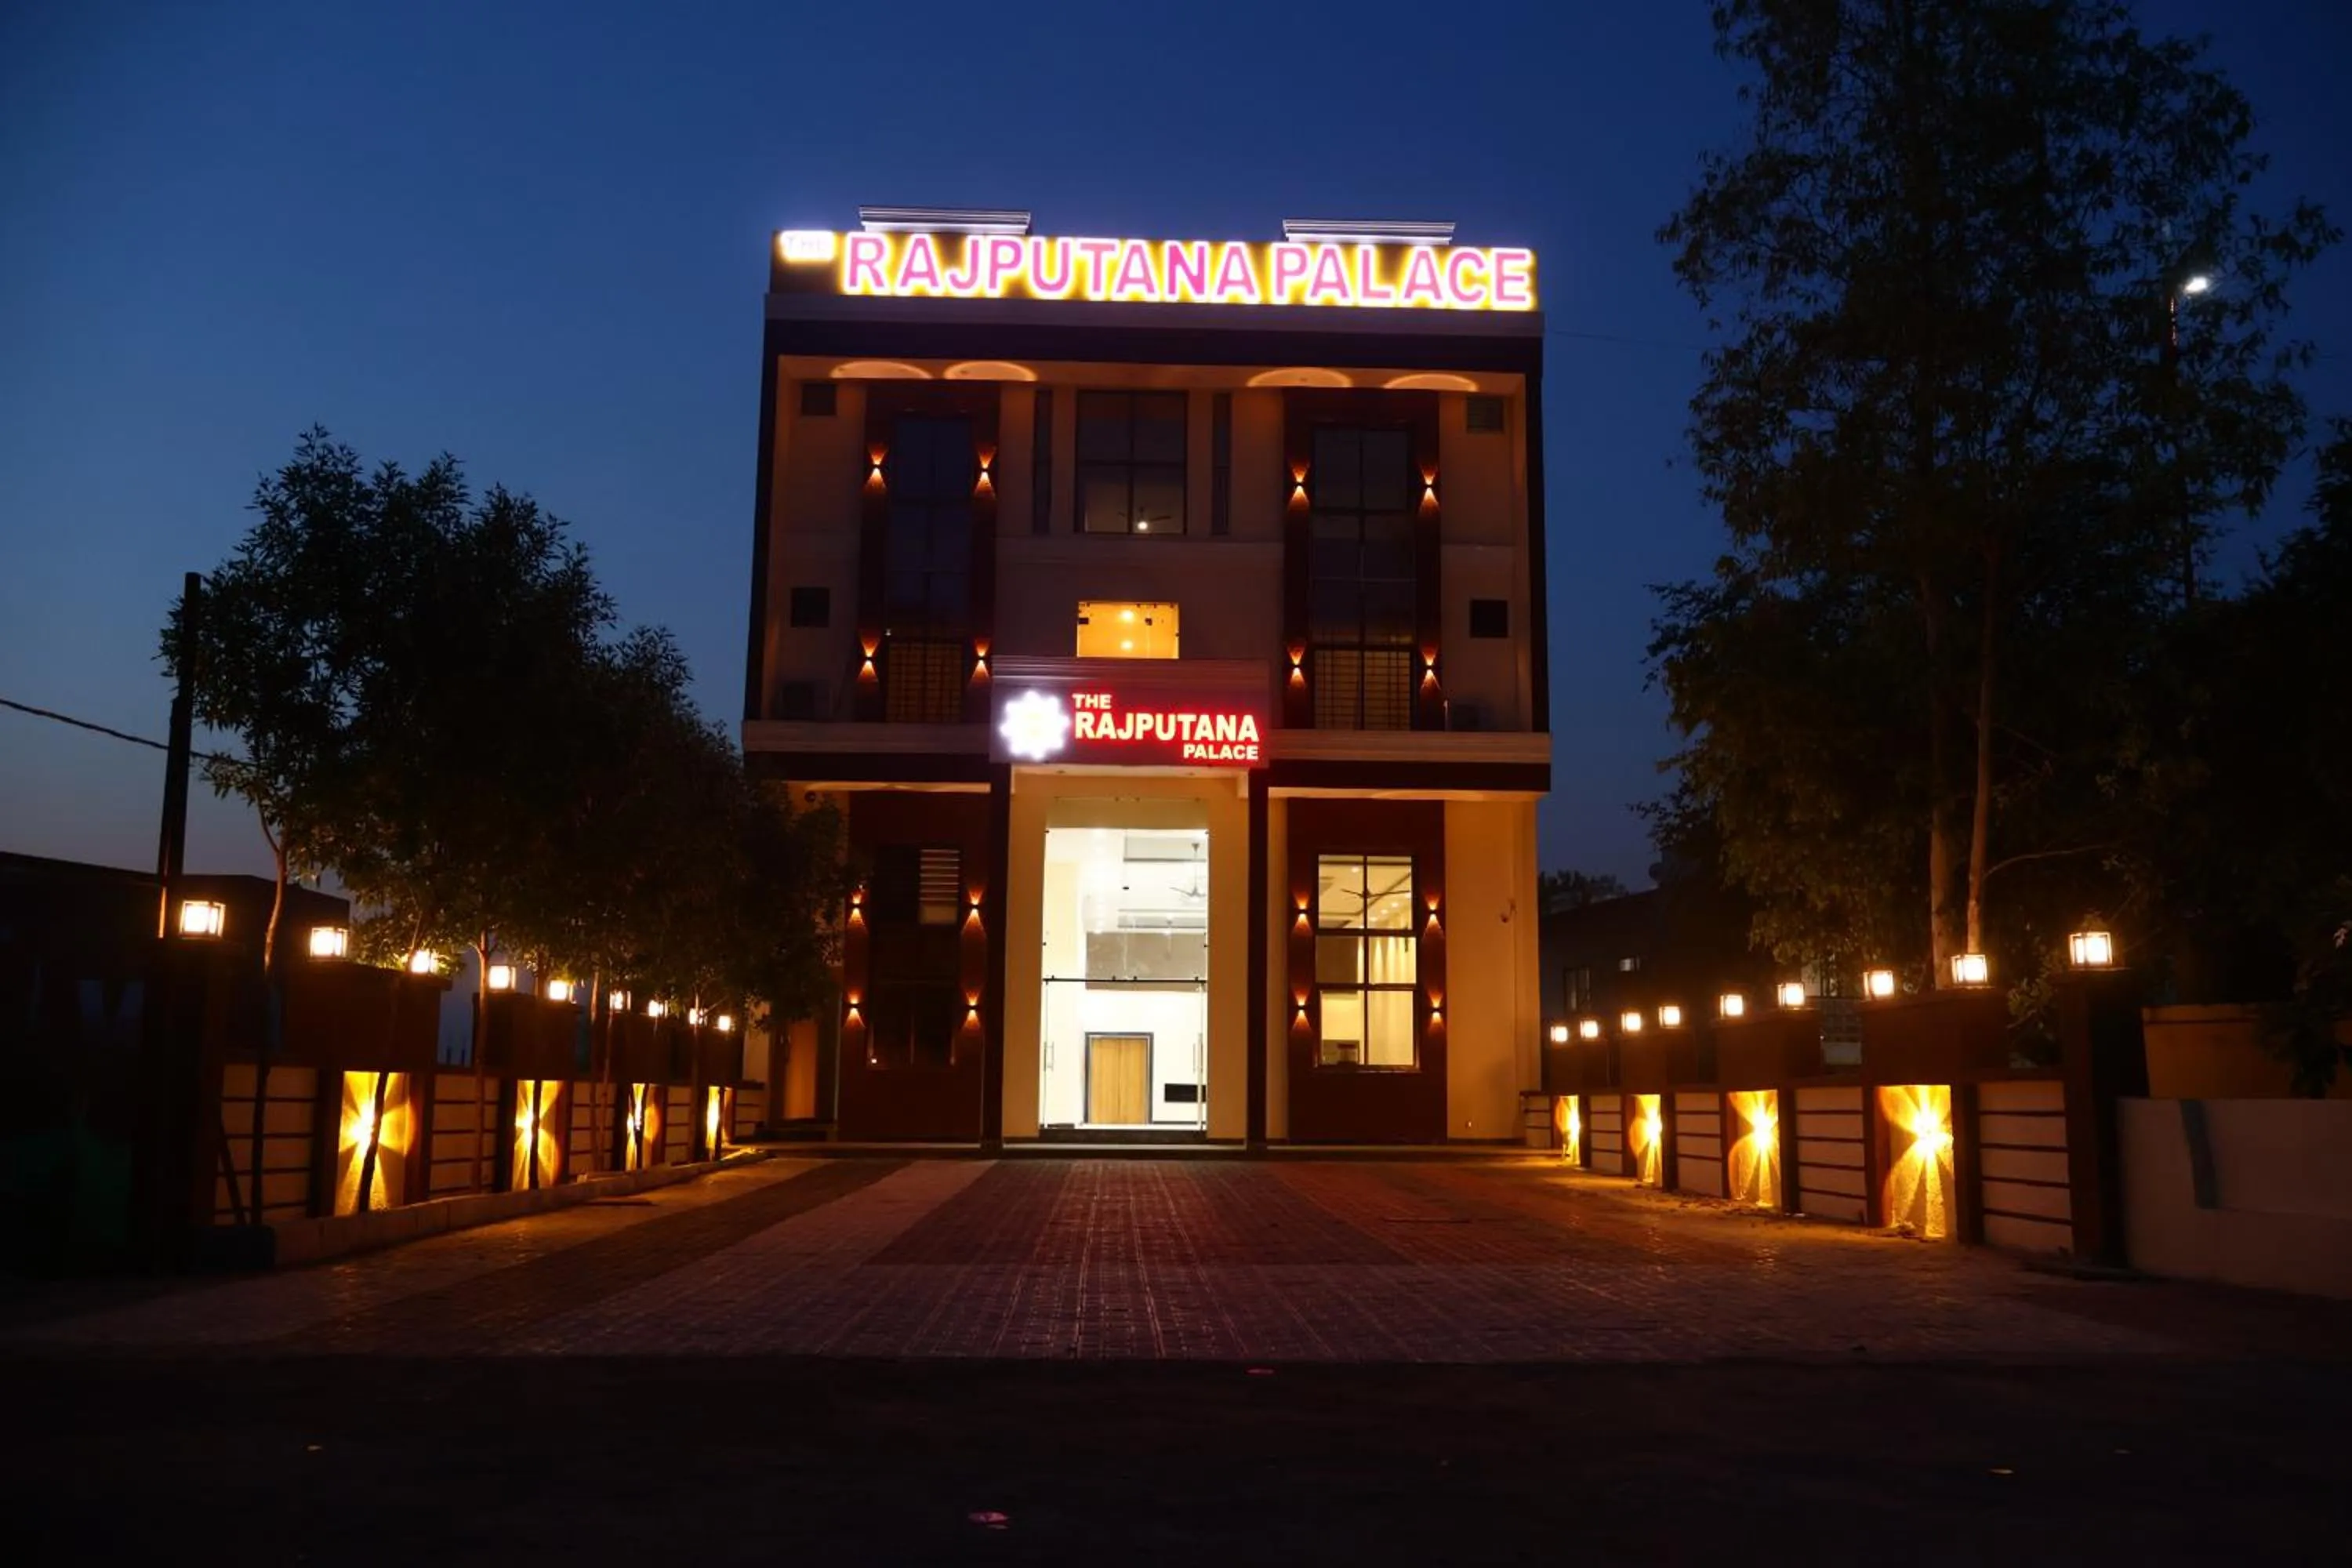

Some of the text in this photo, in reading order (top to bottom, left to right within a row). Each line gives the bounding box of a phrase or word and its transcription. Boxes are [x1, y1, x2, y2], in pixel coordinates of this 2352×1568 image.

[846, 235, 1257, 299] RAJPUTANA
[1273, 245, 1532, 306] PALACE
[1073, 694, 1112, 710] THE
[1075, 712, 1259, 742] RAJPUTANA
[1183, 745, 1258, 760] PALACE
